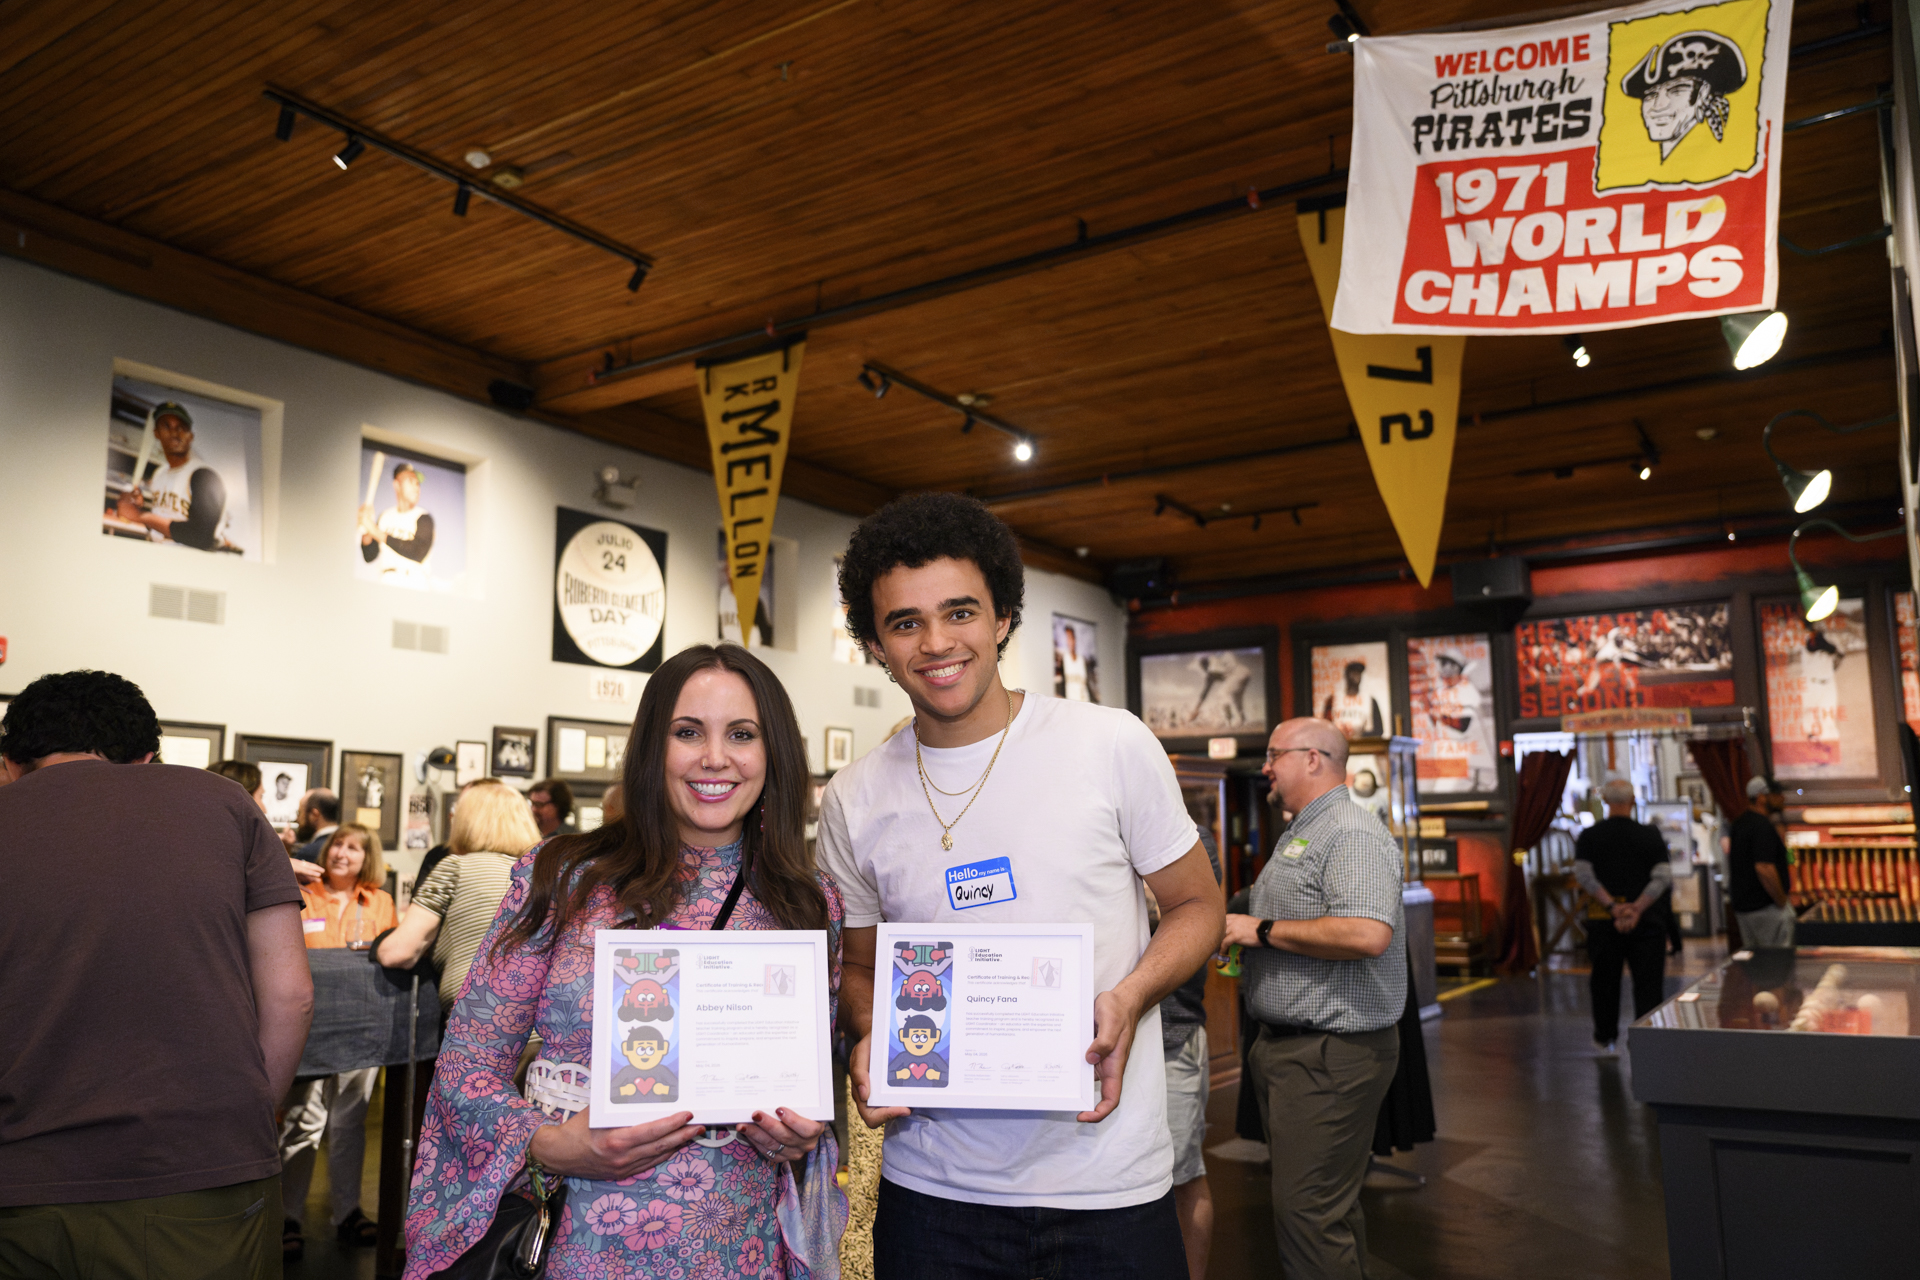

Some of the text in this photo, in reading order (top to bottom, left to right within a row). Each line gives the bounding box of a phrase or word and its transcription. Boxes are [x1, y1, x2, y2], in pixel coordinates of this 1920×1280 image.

[1434, 34, 1590, 79] WELCOME
[1430, 68, 1585, 109] Pittsburgh
[1411, 97, 1593, 155] PIRATES
[1434, 161, 1569, 219] 1971
[1444, 194, 1727, 268] WORLD
[1403, 244, 1744, 318] CHAMPS
[720, 398, 780, 578] MELLON
[596, 533, 634, 551] JULIO
[602, 550, 627, 573] 24
[563, 571, 610, 607] ROBERTO
[589, 607, 631, 627] DAY
[1566, 612, 1637, 642] WAS
[1520, 686, 1654, 718] SECOND
[948, 867, 979, 882] Hello
[955, 883, 994, 901] Quincy
[696, 1003, 753, 1013] Abbey Nilson
[966, 995, 995, 1005] Quincy
